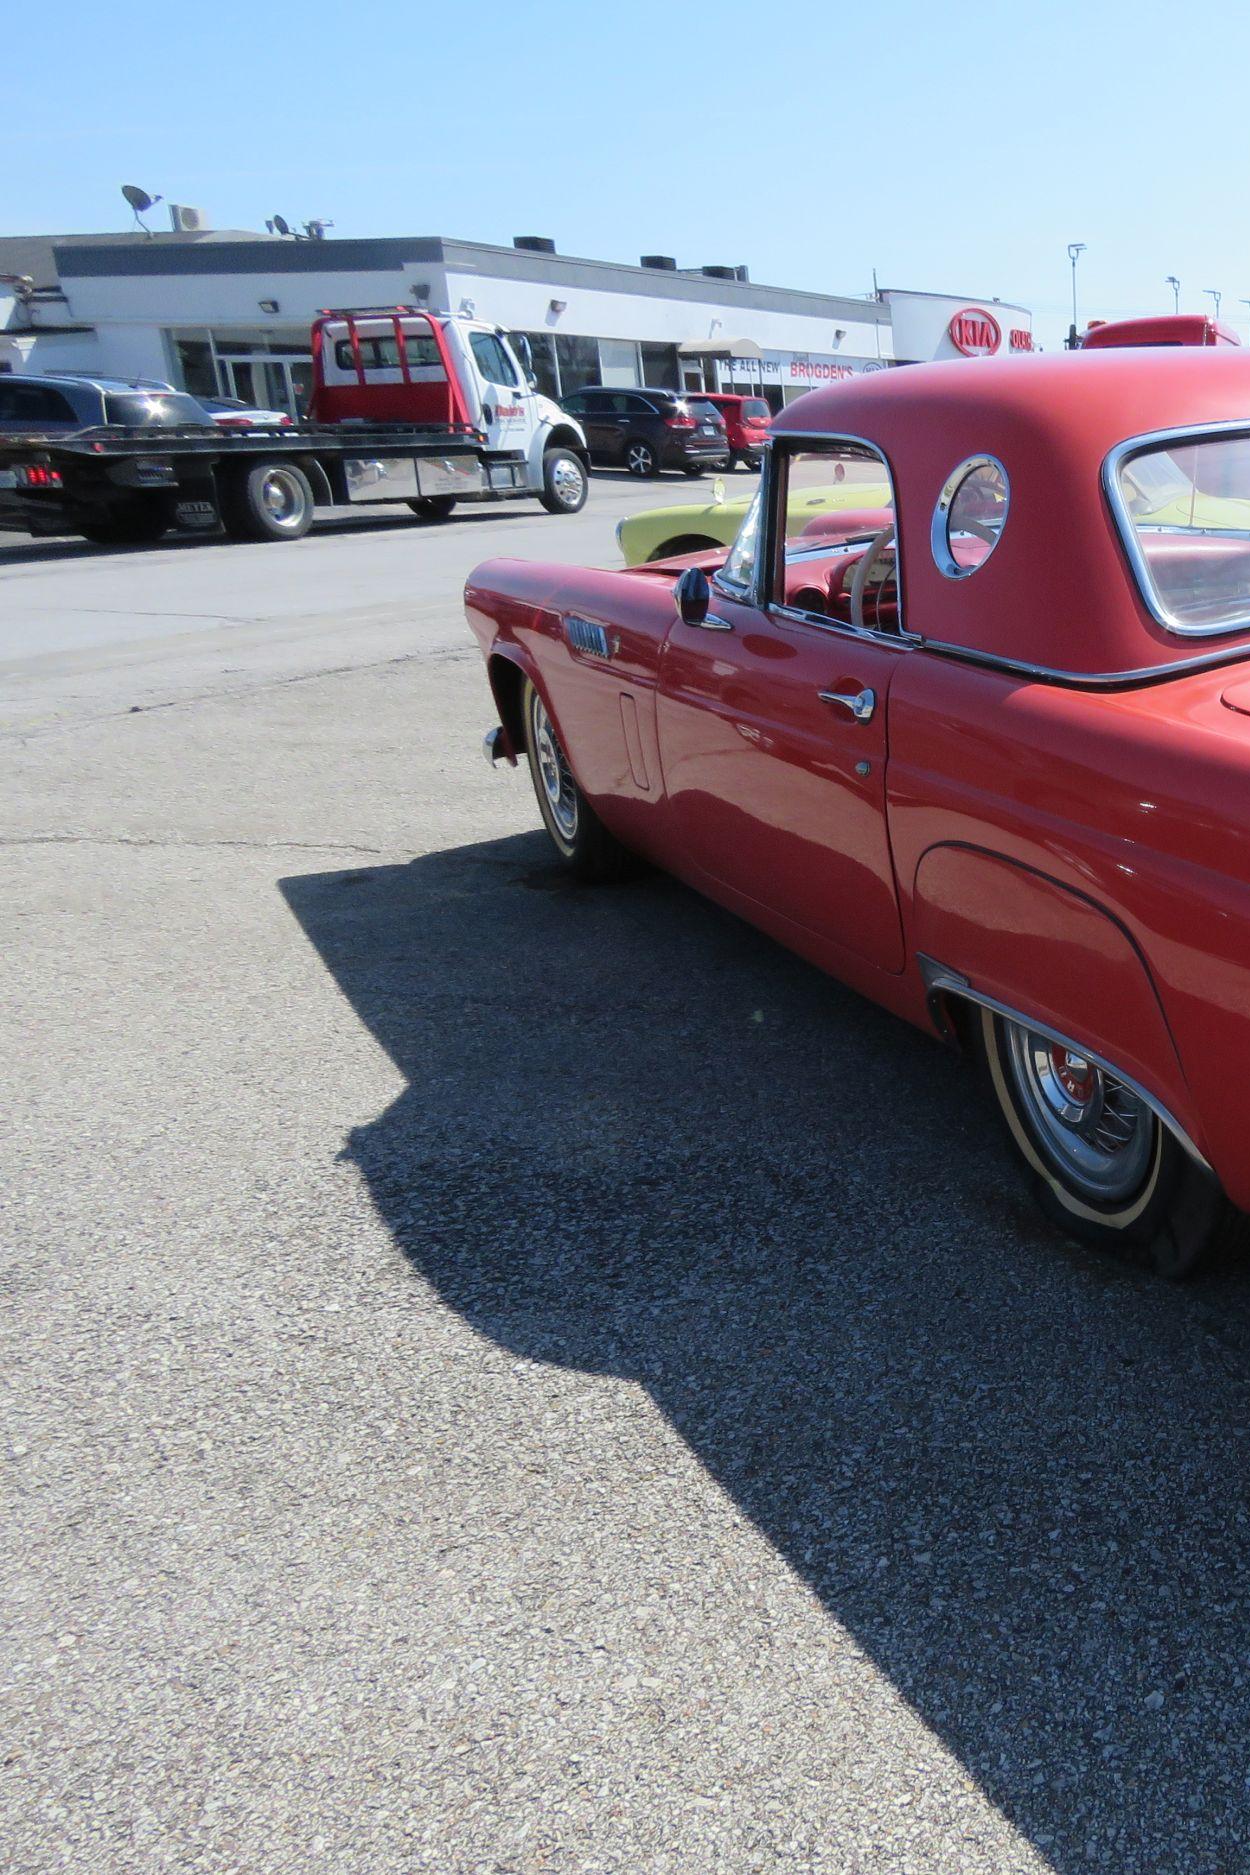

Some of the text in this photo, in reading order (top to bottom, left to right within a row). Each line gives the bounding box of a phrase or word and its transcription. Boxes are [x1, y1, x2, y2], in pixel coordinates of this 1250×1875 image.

[958, 317, 996, 350] KIA
[719, 358, 780, 374] THE ALL NEW
[790, 361, 854, 380] BROGDEN'S
